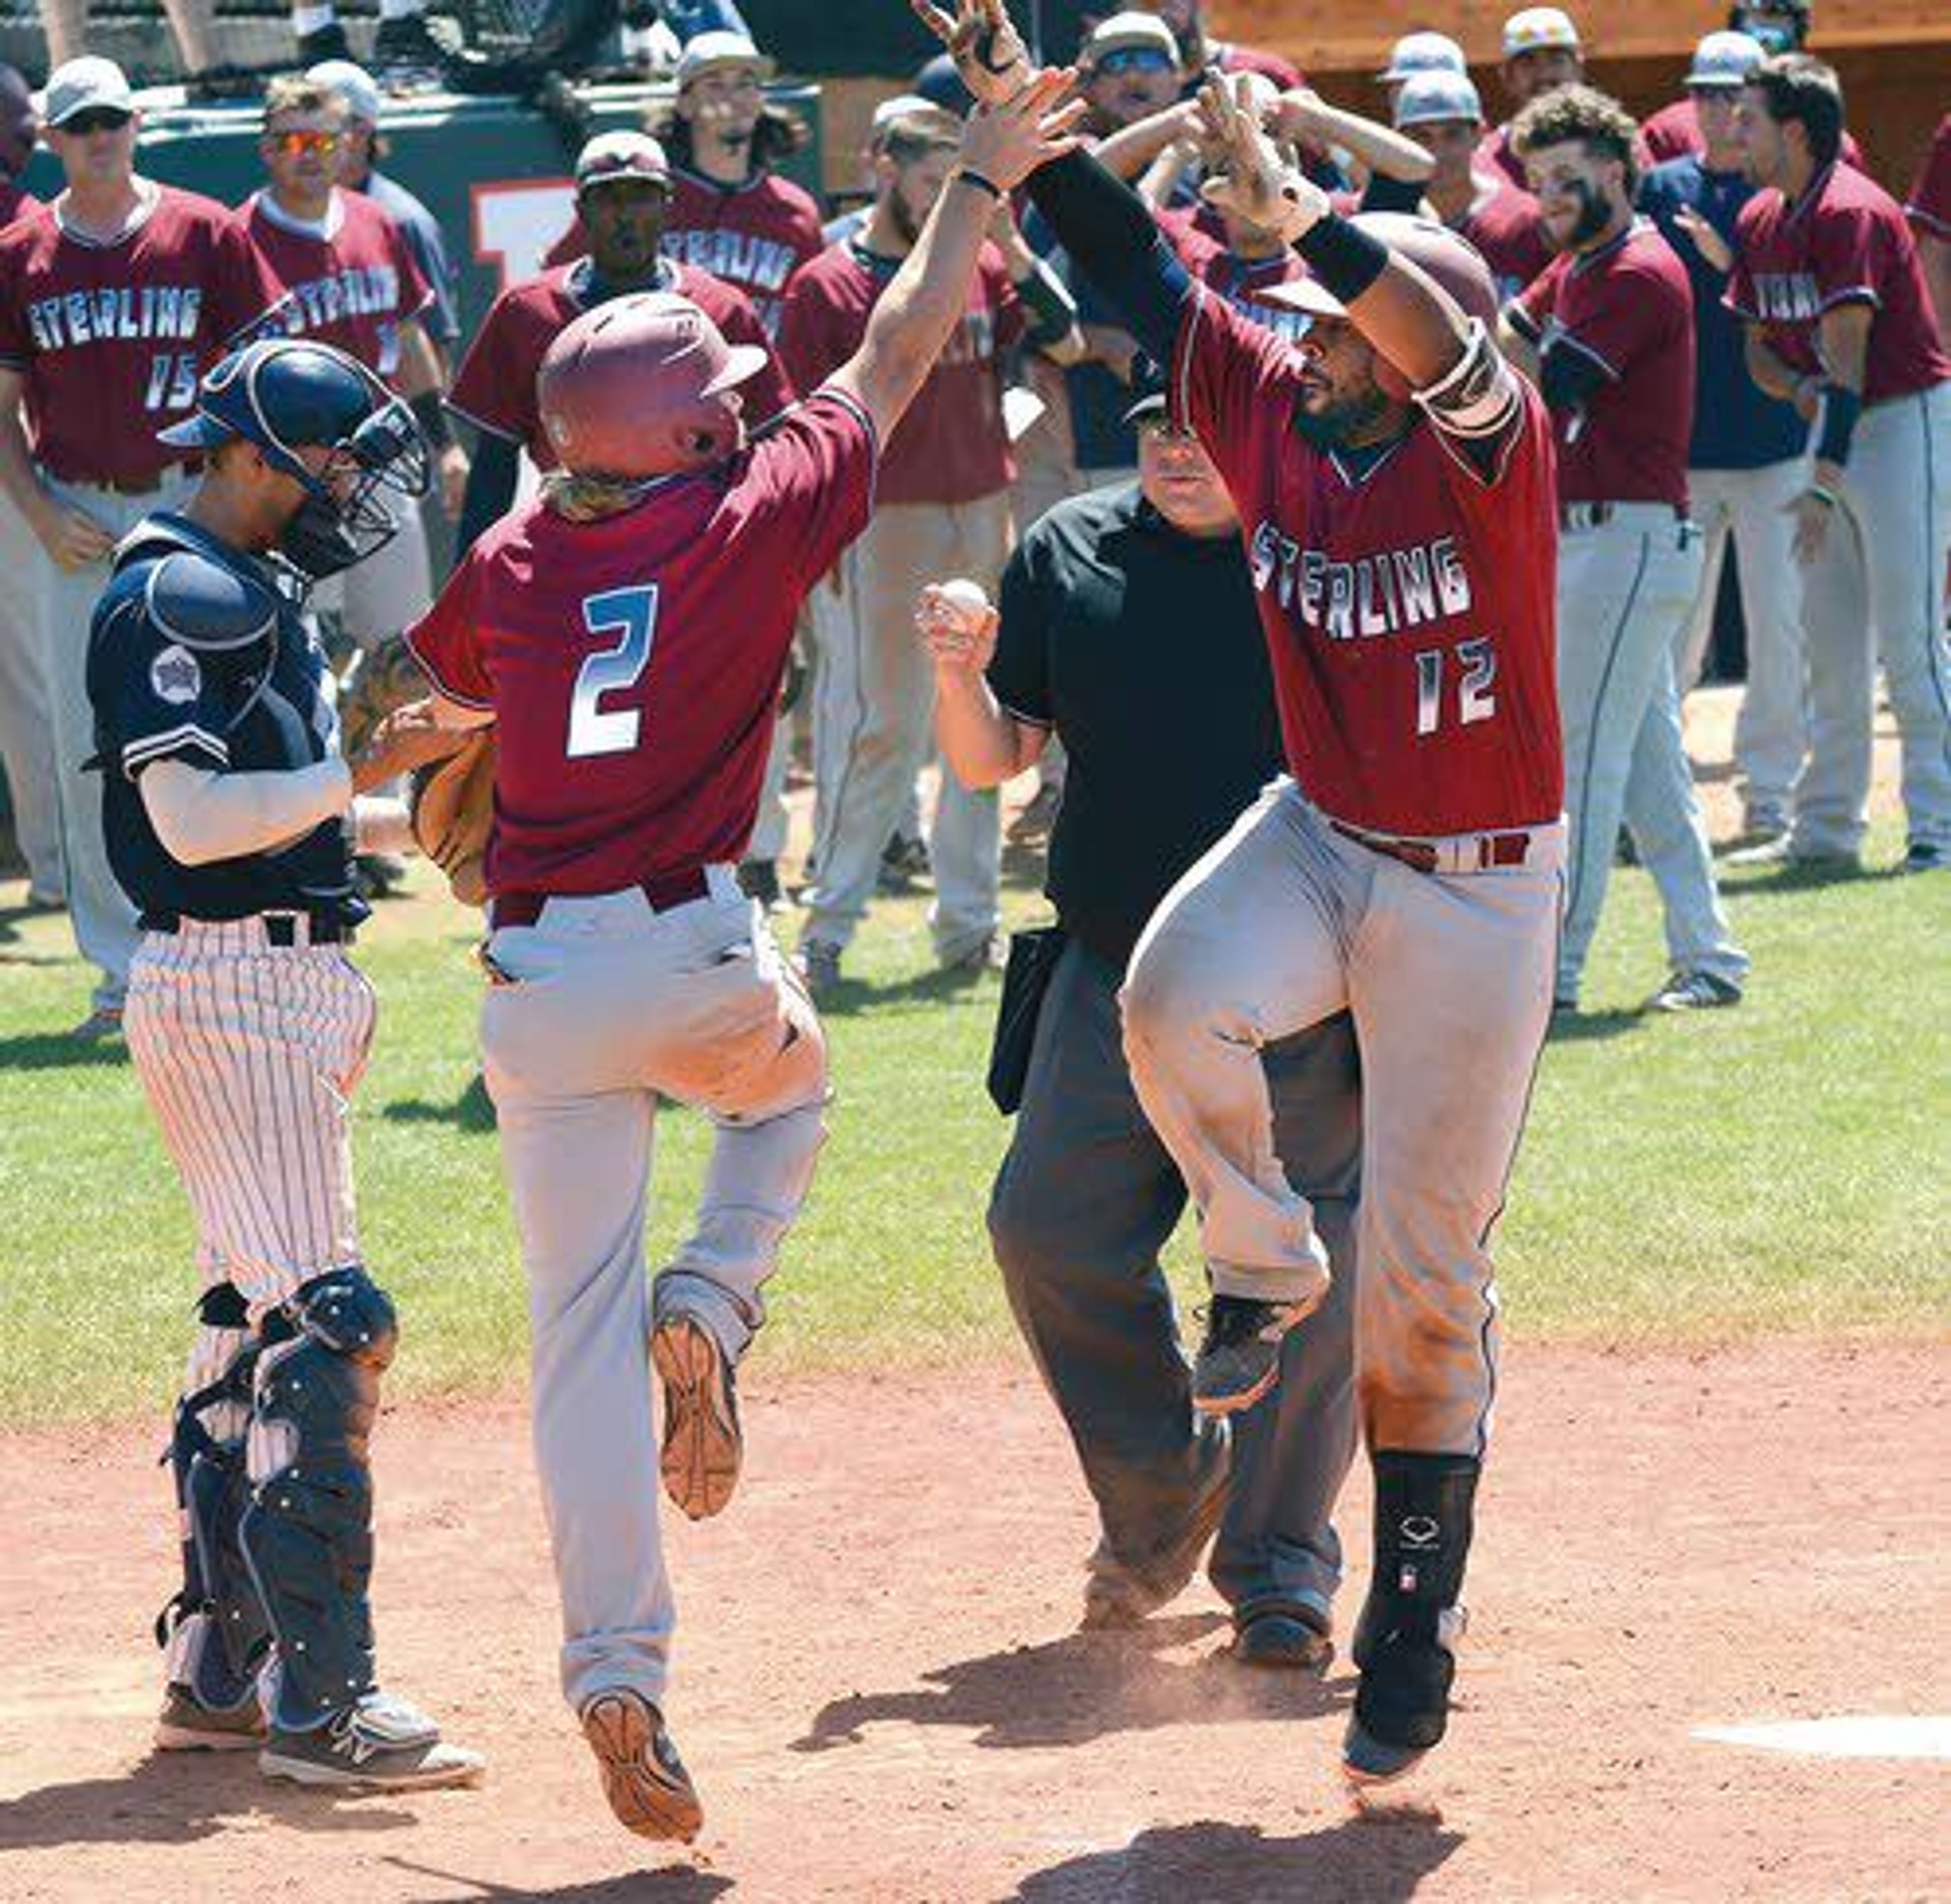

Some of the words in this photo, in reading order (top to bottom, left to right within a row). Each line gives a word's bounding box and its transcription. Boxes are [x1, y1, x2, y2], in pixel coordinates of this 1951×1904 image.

[28, 287, 202, 349] STERLING
[145, 353, 197, 409] 15
[1251, 519, 1471, 640] STERLING
[566, 583, 658, 757] 2
[1415, 636, 1498, 736] 12
